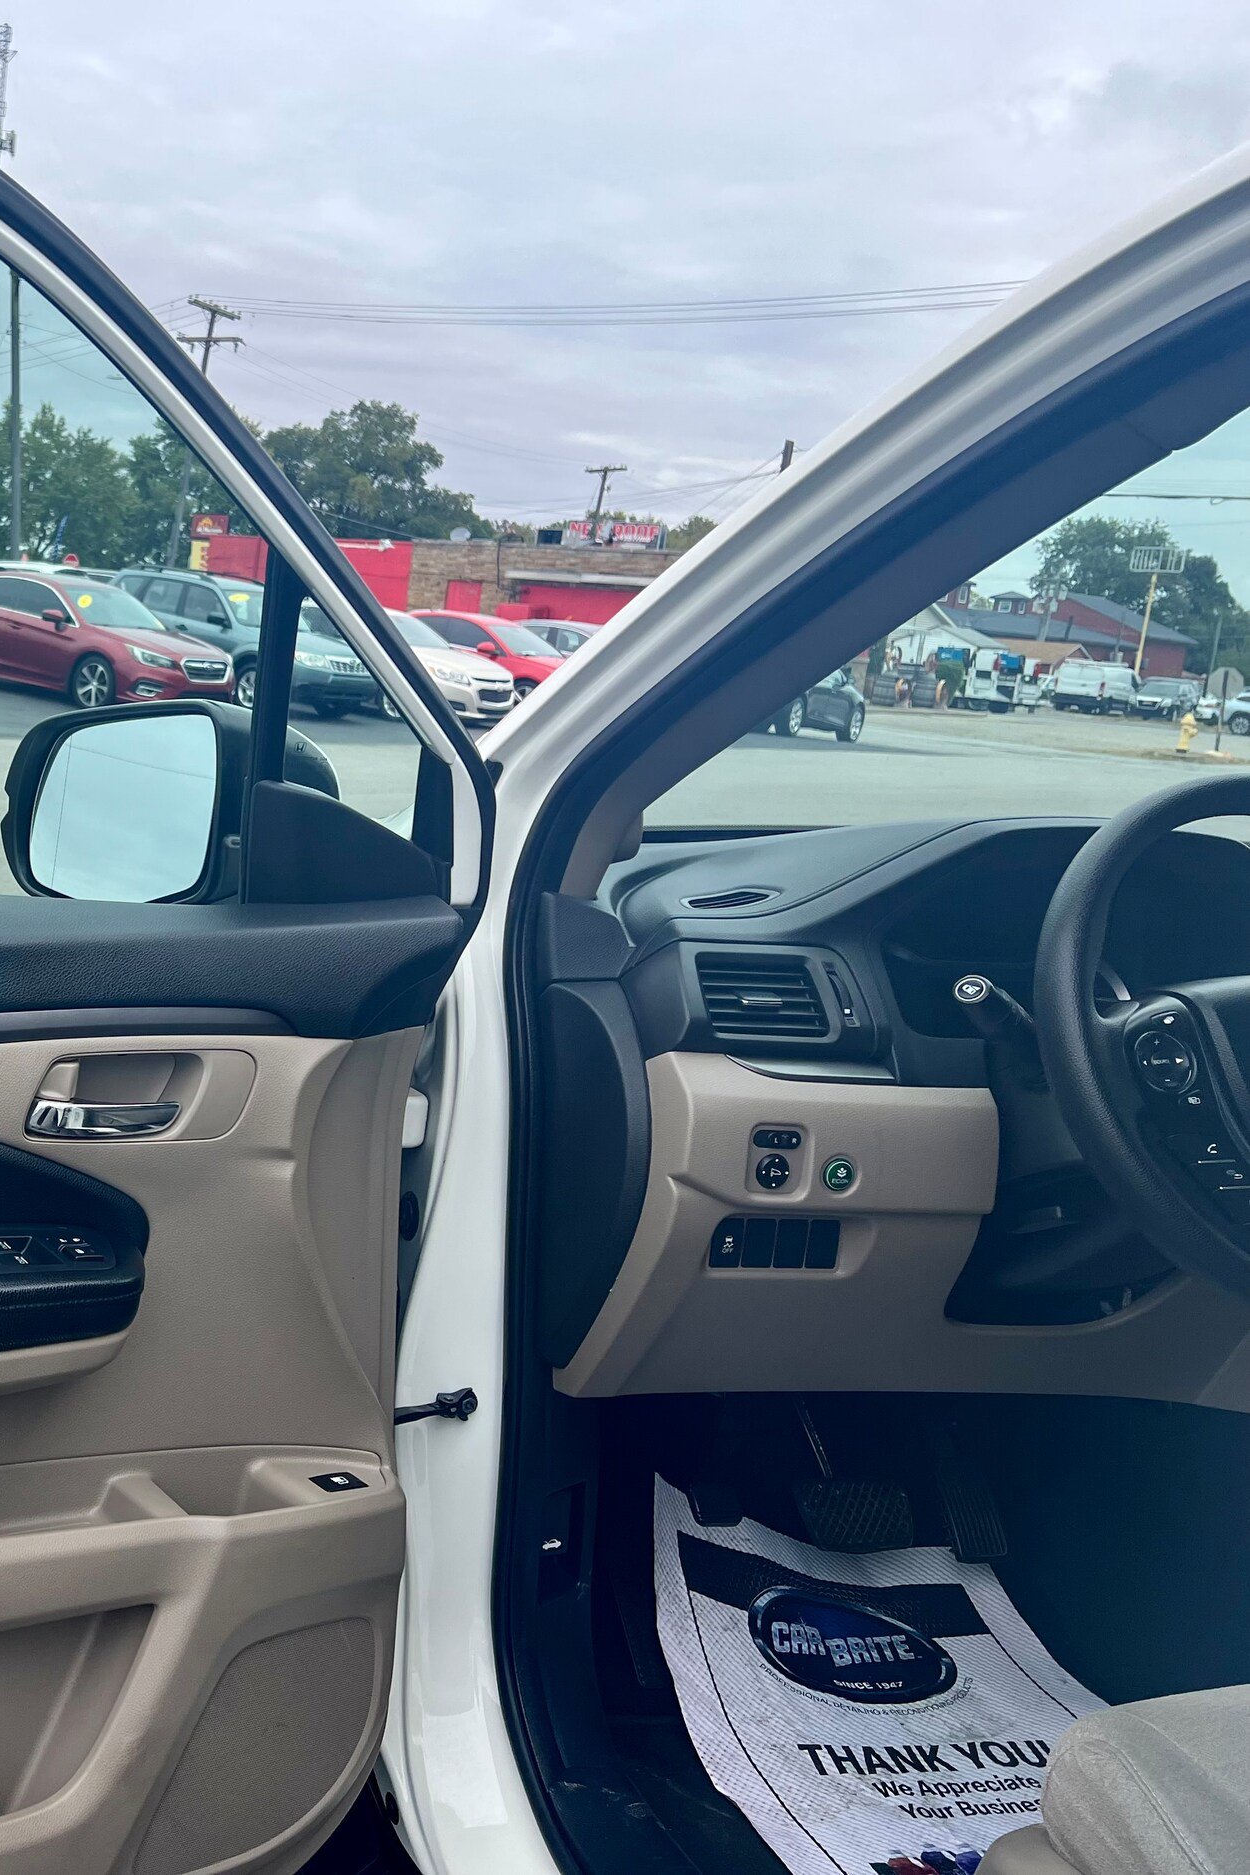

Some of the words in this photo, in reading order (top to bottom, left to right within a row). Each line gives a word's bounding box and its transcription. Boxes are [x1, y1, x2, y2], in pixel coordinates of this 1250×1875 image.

[771, 1621, 826, 1656] CAR
[824, 1634, 915, 1668] BRITE
[759, 1663, 833, 1707] PROFESSIONAL
[833, 1679, 874, 1690] SINCE
[875, 1681, 903, 1690] 1947
[797, 1743, 958, 1776] THANK
[872, 1779, 913, 1798] We
[919, 1774, 1042, 1798] Appreciate
[898, 1801, 953, 1819] Your
[955, 1798, 1041, 1817] Busine
